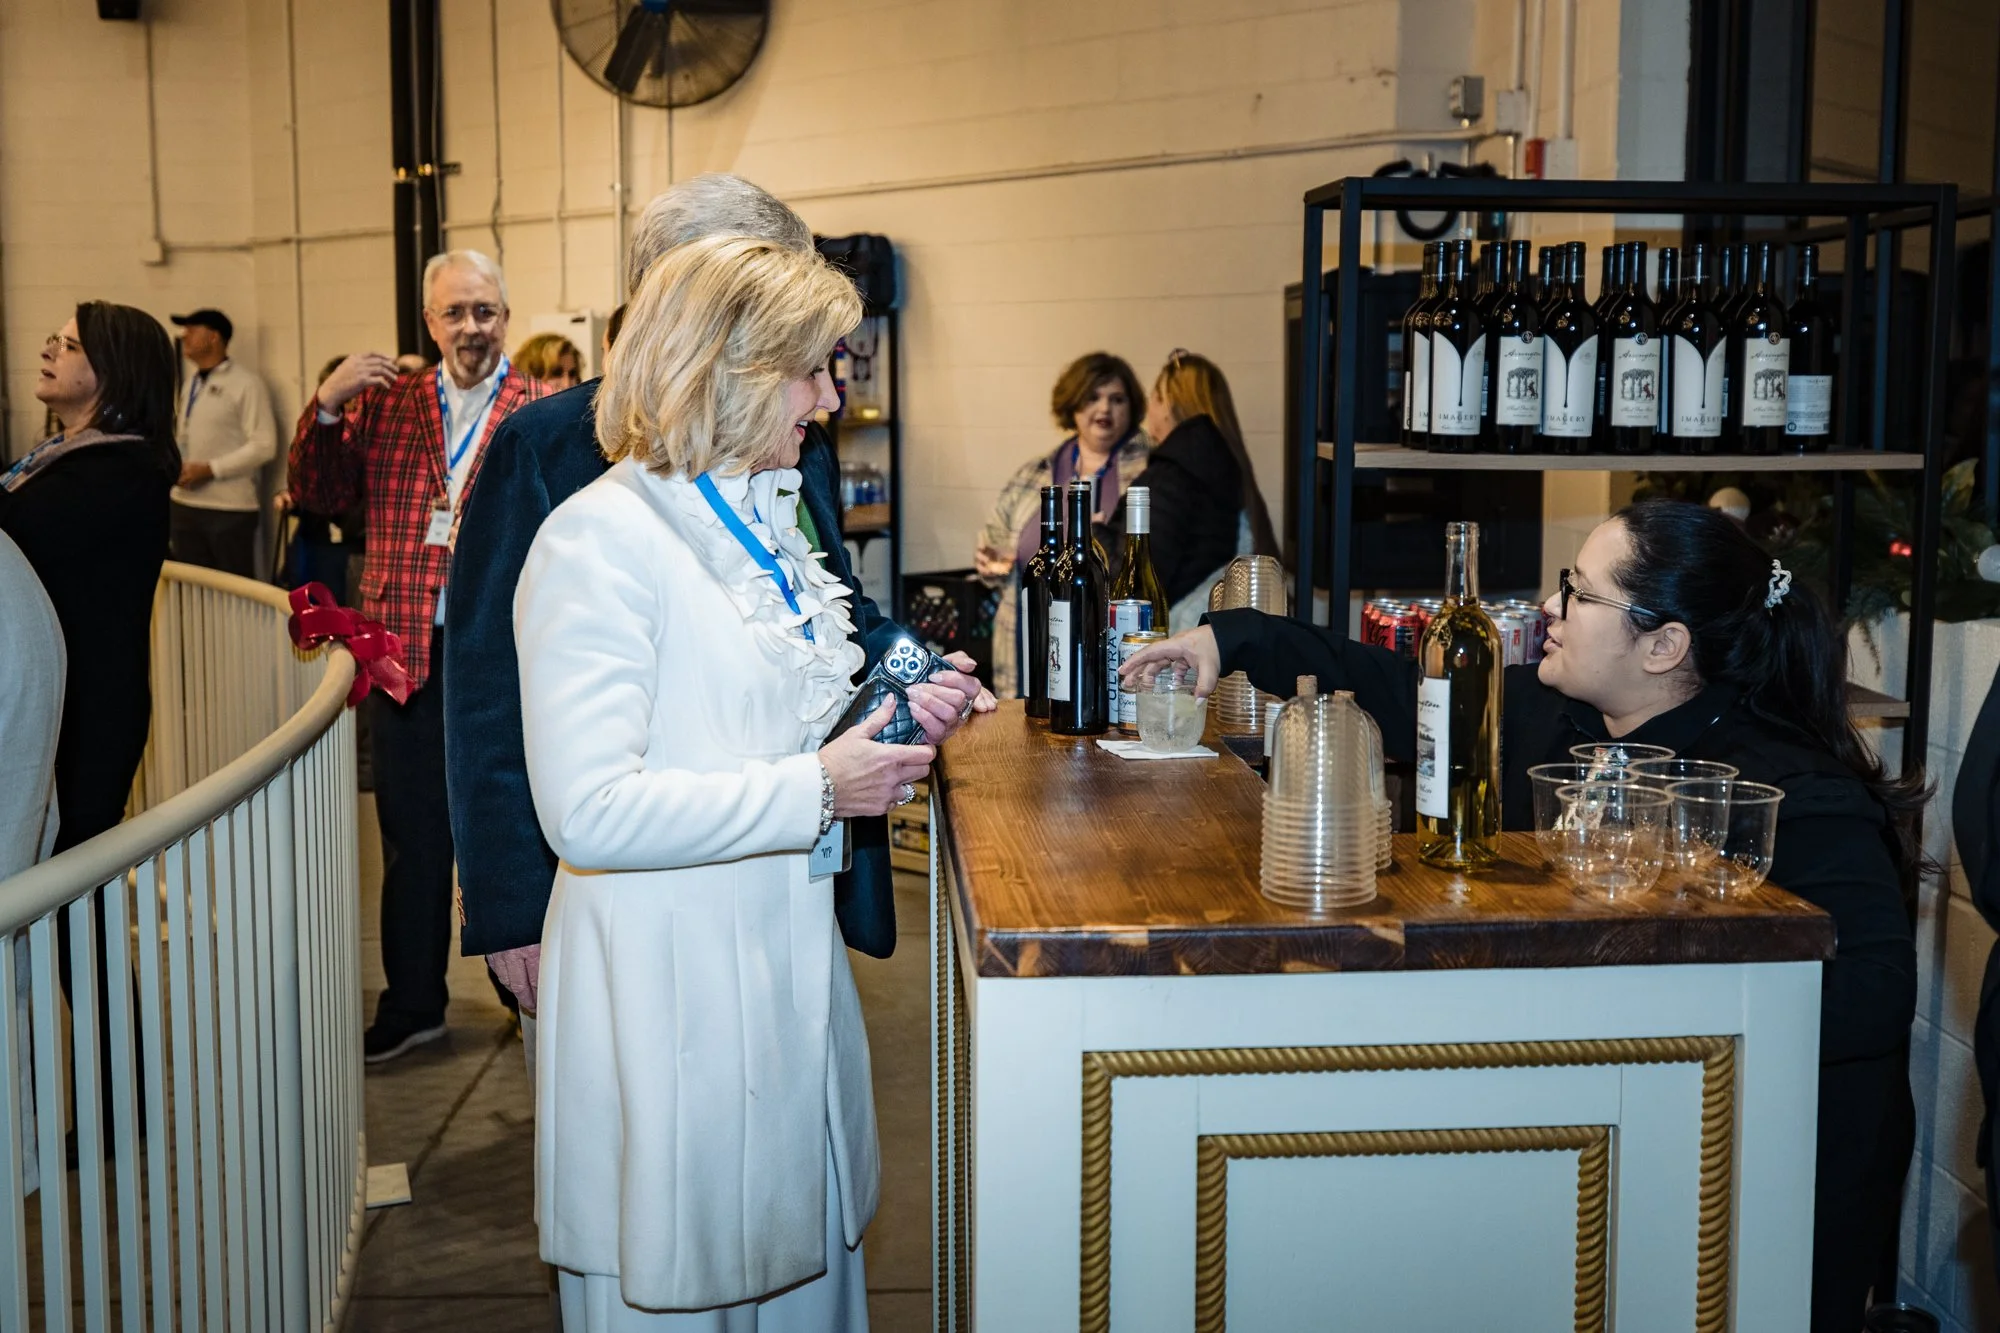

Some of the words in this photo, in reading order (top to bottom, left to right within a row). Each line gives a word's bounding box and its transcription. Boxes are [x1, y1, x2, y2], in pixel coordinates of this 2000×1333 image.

[1439, 411, 1477, 423] IMAGERY
[1546, 414, 1585, 424] IMAGERY
[821, 846, 833, 858] VIP
